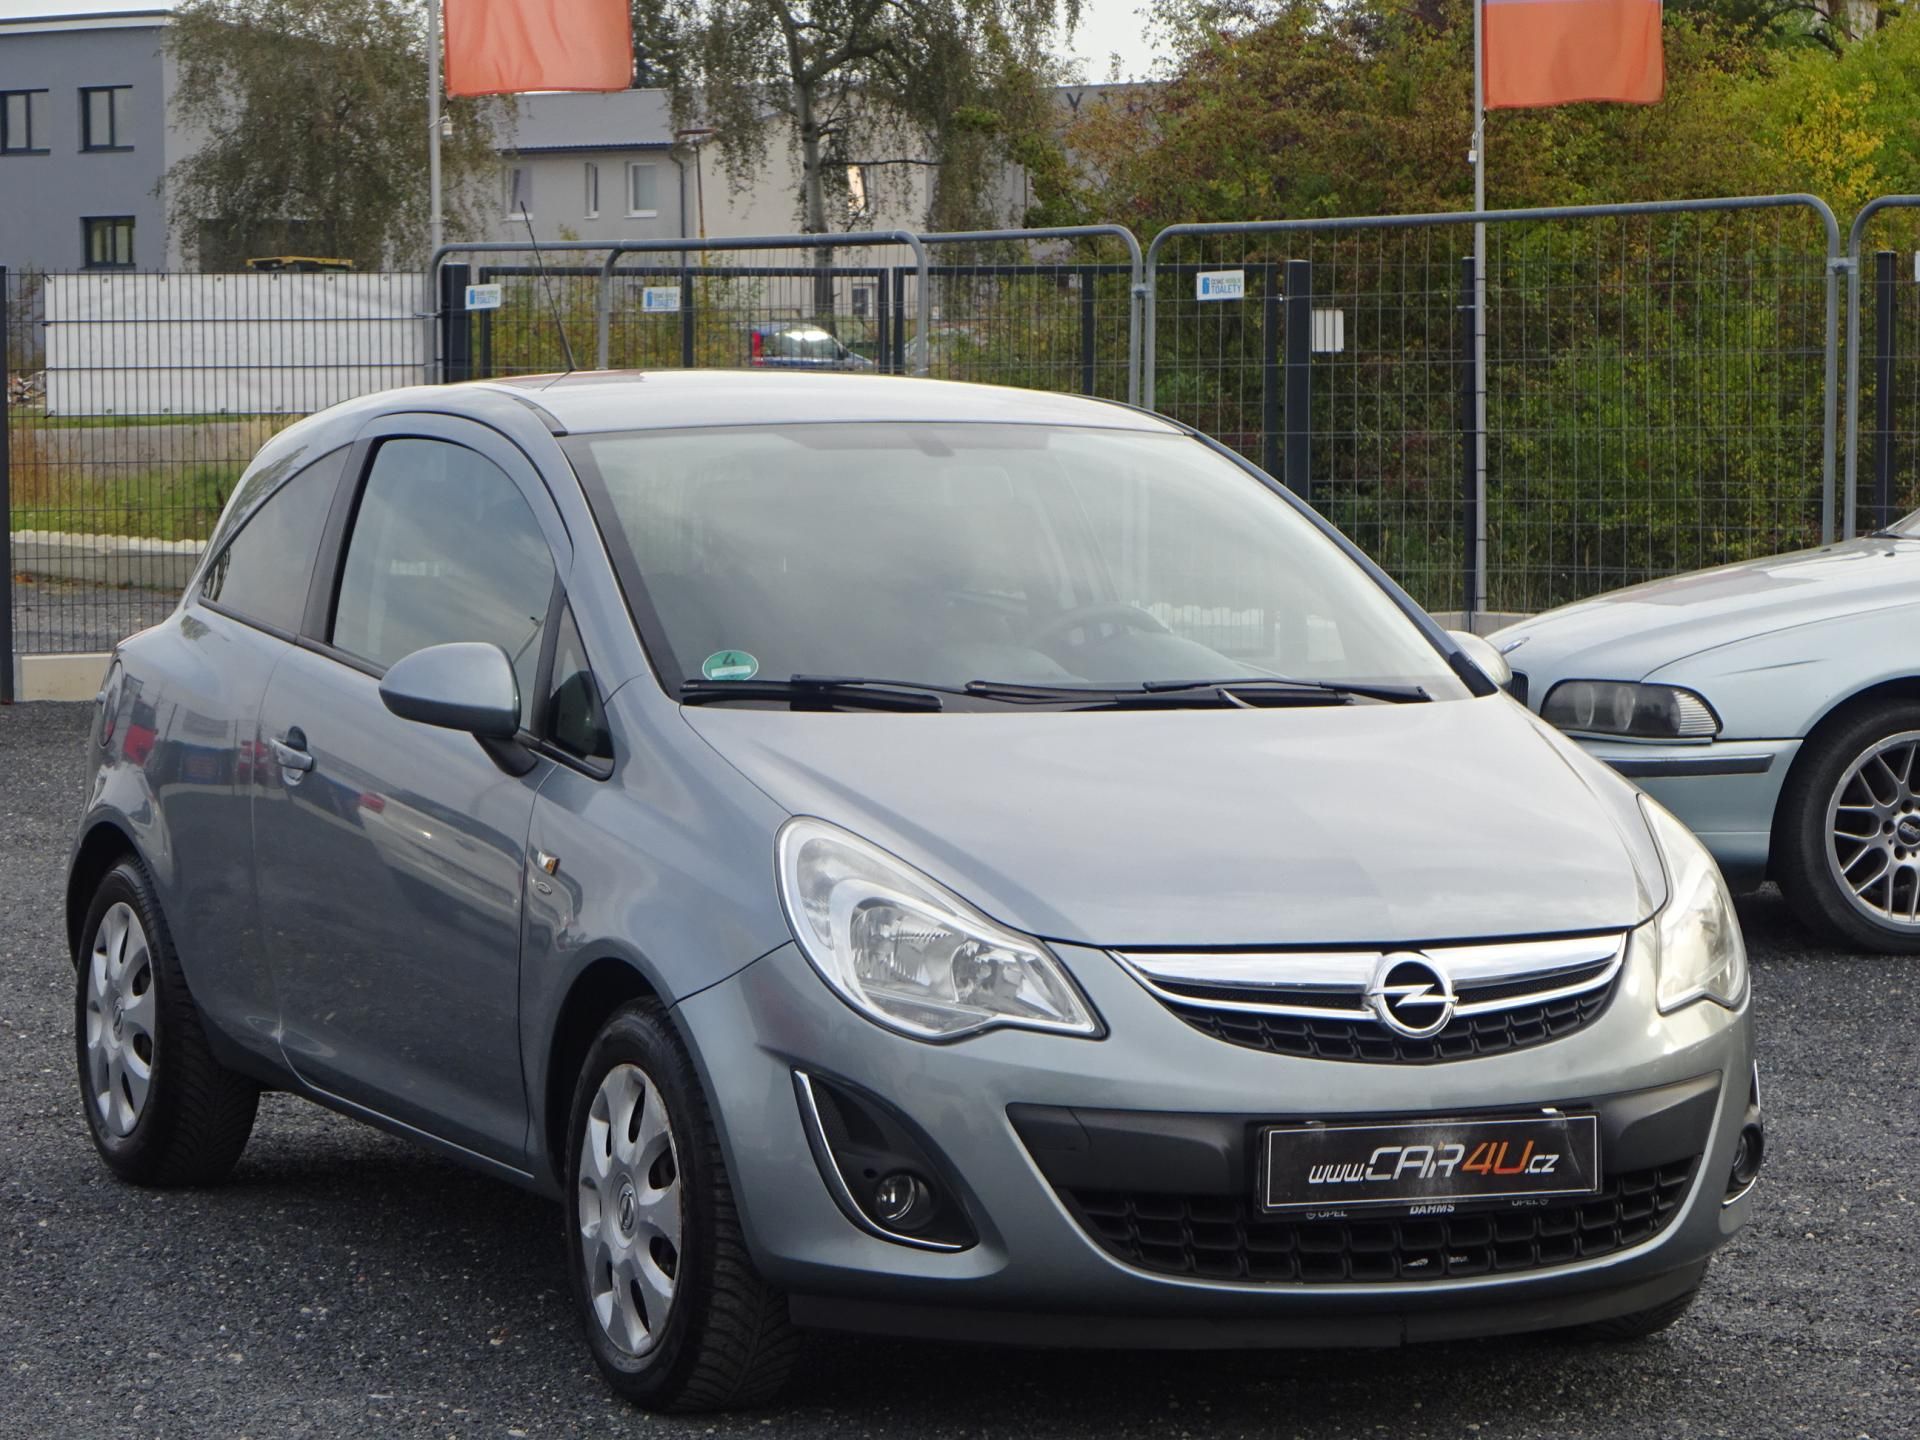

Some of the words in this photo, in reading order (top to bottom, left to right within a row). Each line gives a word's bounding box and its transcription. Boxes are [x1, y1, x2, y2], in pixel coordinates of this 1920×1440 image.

[1211, 284, 1242, 296] TOALETY
[722, 653, 737, 666] 4
[1308, 1140, 1560, 1184] www.CAR4U.cz
[1409, 1203, 1455, 1215] DAHMS
